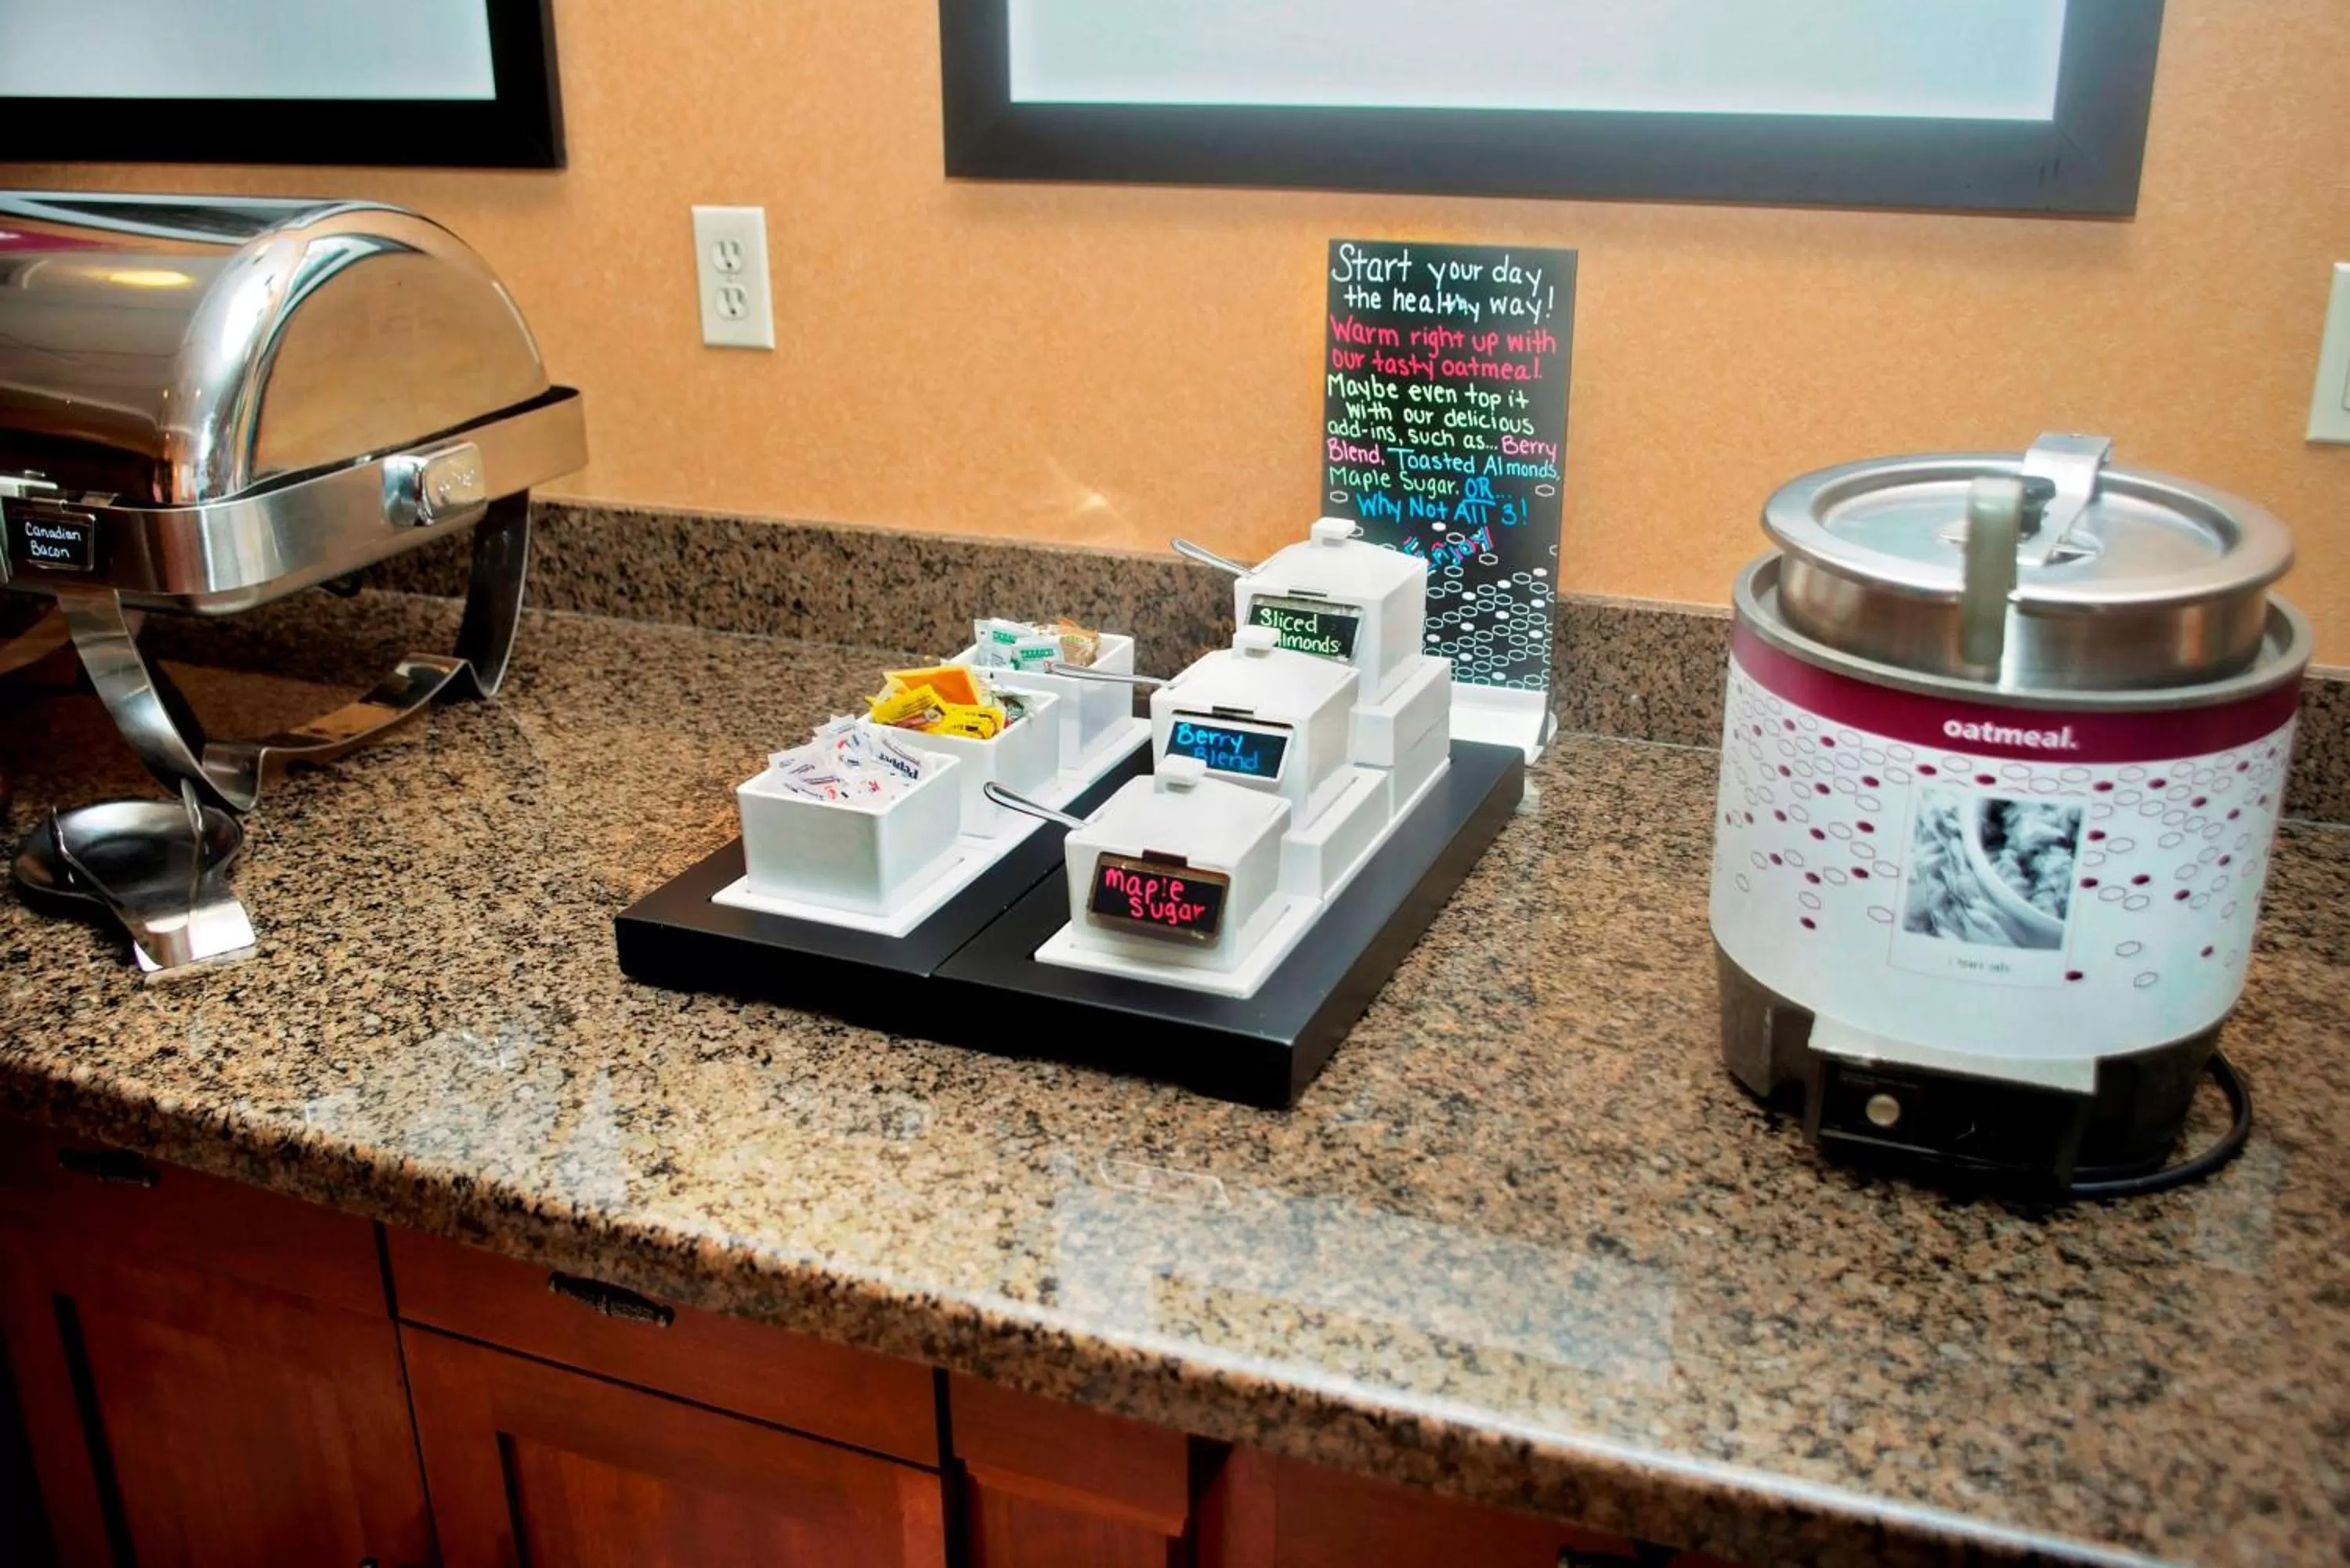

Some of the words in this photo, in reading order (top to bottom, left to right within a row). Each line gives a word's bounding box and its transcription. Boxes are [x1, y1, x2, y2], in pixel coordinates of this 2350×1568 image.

[1331, 243, 1412, 283] Start
[1427, 260, 1484, 291] your
[1492, 253, 1542, 298] day
[1343, 284, 1382, 309] the
[1393, 287, 1480, 323] healthy
[1490, 285, 1554, 325] way!
[1329, 313, 1400, 347] Warm
[1410, 325, 1465, 359] right
[1472, 331, 1499, 356] up
[1506, 328, 1556, 355] with
[1372, 350, 1434, 381] tasty
[1328, 372, 1399, 401] Maybe
[1408, 384, 1457, 404] even
[1464, 382, 1502, 411] top
[1508, 389, 1529, 409] it
[1345, 399, 1393, 422] with
[1403, 407, 1434, 425] our
[1444, 408, 1535, 435] delicious
[1386, 446, 1475, 475] Toasted
[1408, 428, 1455, 450] such
[1502, 435, 1557, 464] Berry
[1329, 466, 1391, 493] Maple
[1355, 490, 1401, 524] Why
[1409, 494, 1448, 520] Not
[1453, 500, 1488, 525] All
[25, 521, 81, 542] Canadian
[31, 540, 70, 558] Bacon
[1260, 608, 1318, 634] Sliced
[1177, 723, 1244, 754] Berry
[1943, 719, 2081, 750] oatmeal.
[1194, 746, 1259, 770] Blend
